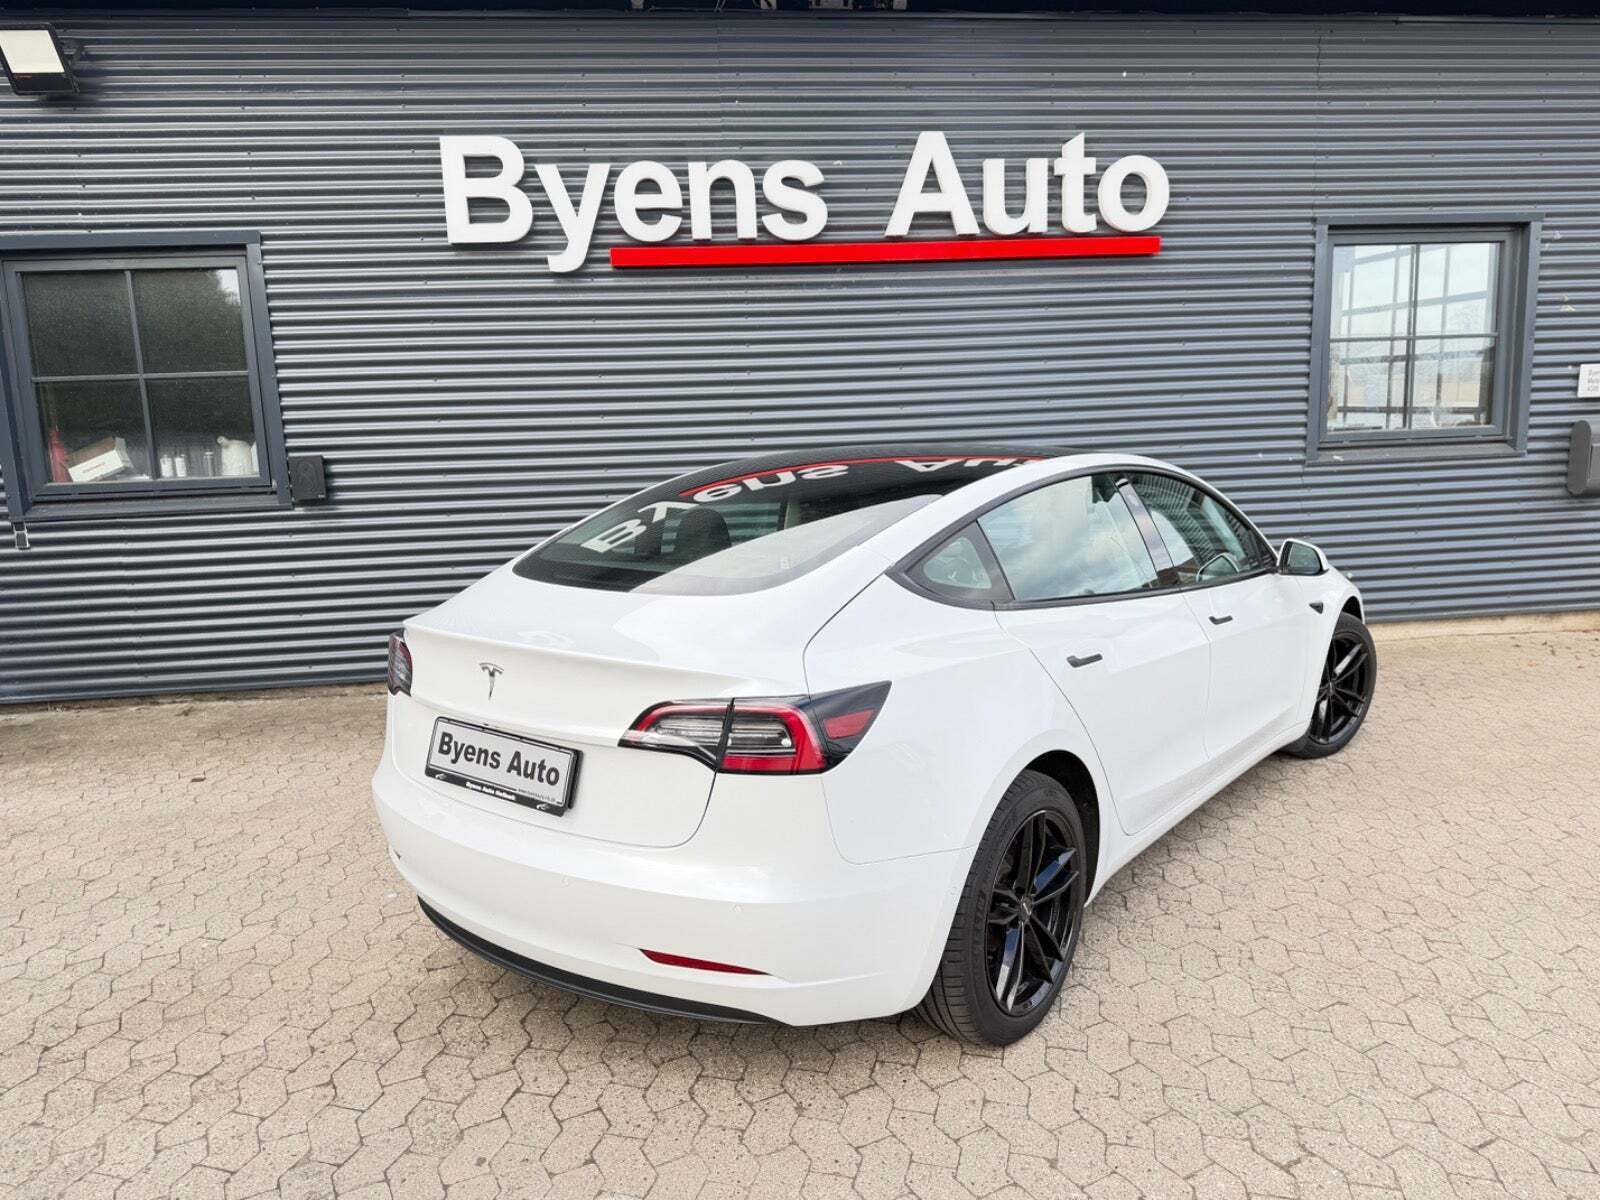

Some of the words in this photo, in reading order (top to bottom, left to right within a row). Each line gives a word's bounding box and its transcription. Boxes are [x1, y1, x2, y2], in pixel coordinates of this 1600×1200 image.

[439, 135, 828, 273] Byens
[884, 131, 1170, 237] Auto
[437, 731, 501, 769] Byens
[506, 750, 560, 786] Auto
